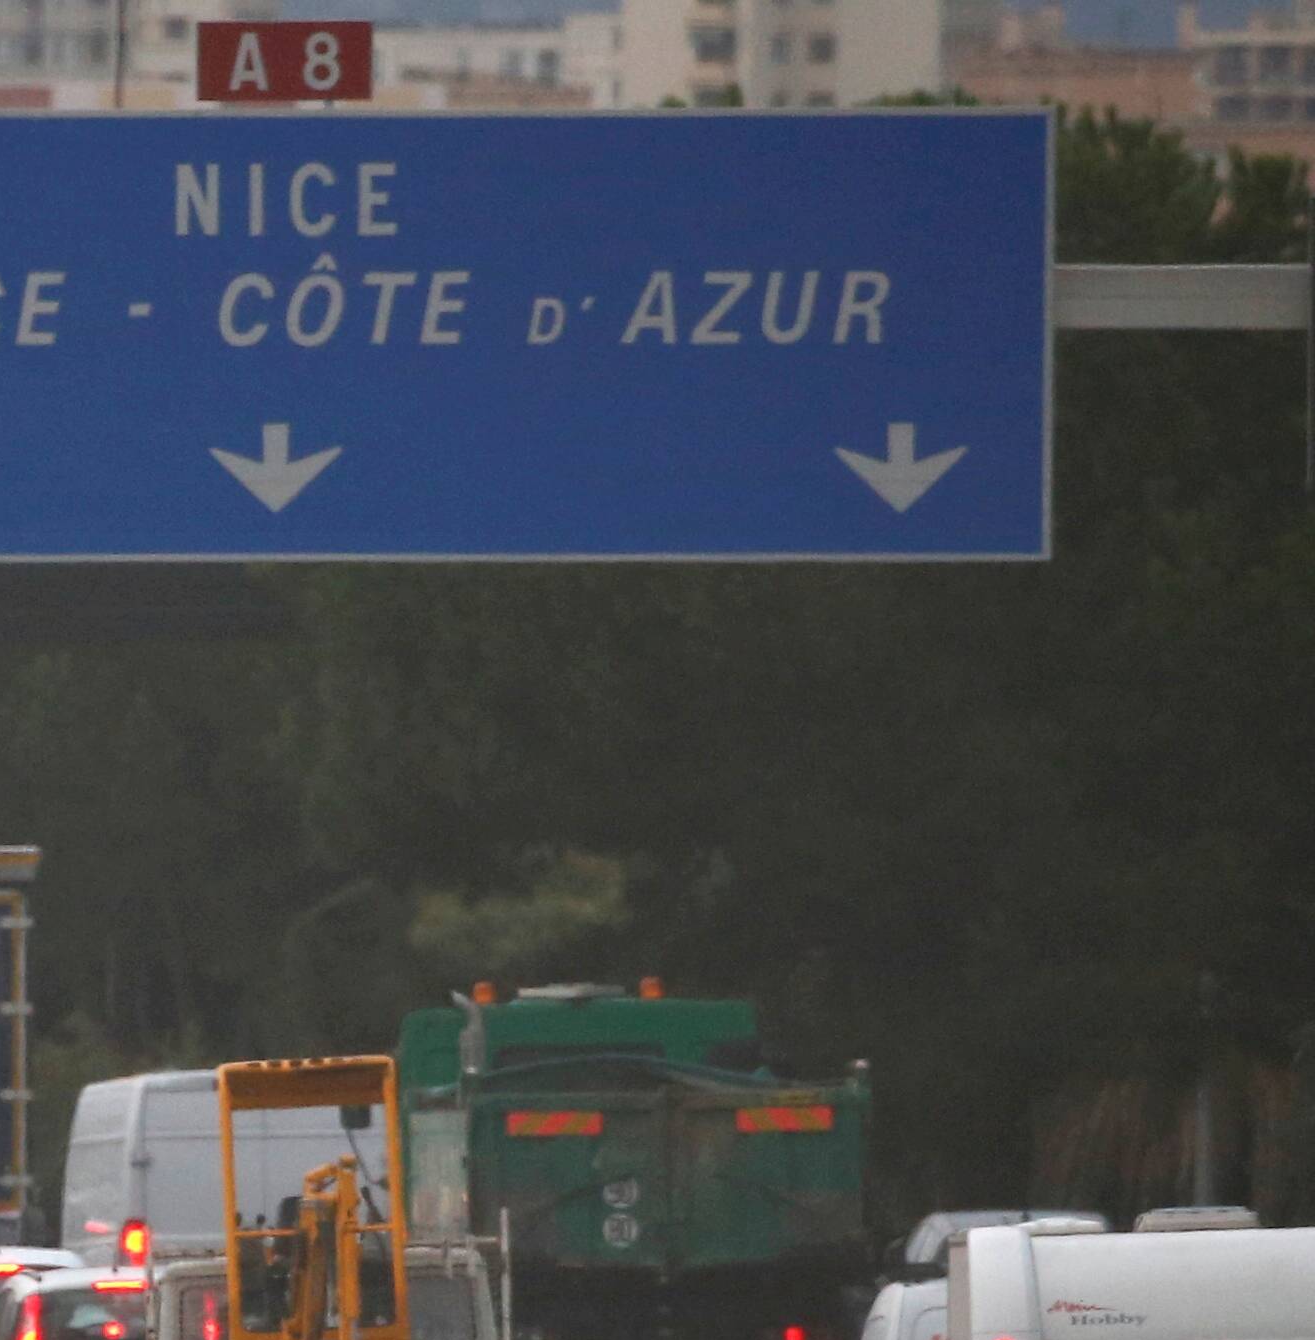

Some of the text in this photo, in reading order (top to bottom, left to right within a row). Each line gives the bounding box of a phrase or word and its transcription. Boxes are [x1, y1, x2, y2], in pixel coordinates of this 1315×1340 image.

[229, 32, 341, 92] A 8
[175, 162, 398, 238] NICE
[218, 253, 469, 347] CÔTE
[621, 270, 891, 345] AZUR
[1070, 1312, 1147, 1326] Hobby
